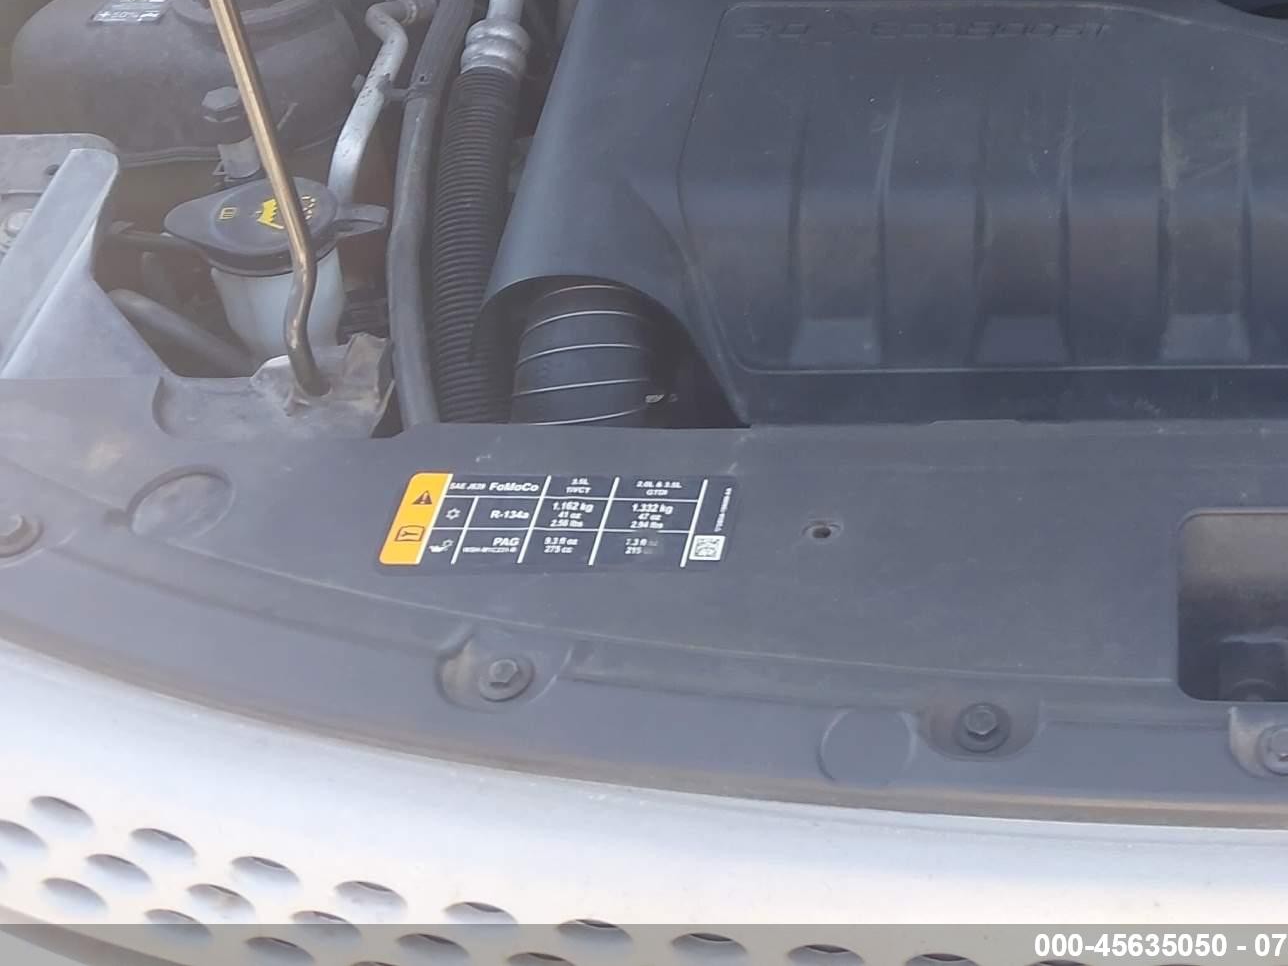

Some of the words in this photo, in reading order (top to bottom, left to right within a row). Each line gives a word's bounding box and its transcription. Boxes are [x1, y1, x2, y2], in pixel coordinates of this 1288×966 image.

[489, 482, 540, 492] FoMoCo
[553, 501, 580, 511] 1.162
[580, 502, 594, 513] kg
[632, 503, 660, 513] 1.332
[659, 504, 674, 515] kg
[490, 509, 530, 519] R-134a
[569, 520, 584, 528] lbs
[649, 521, 664, 529] lbs
[492, 537, 520, 547] PAG
[544, 545, 561, 553] 275
